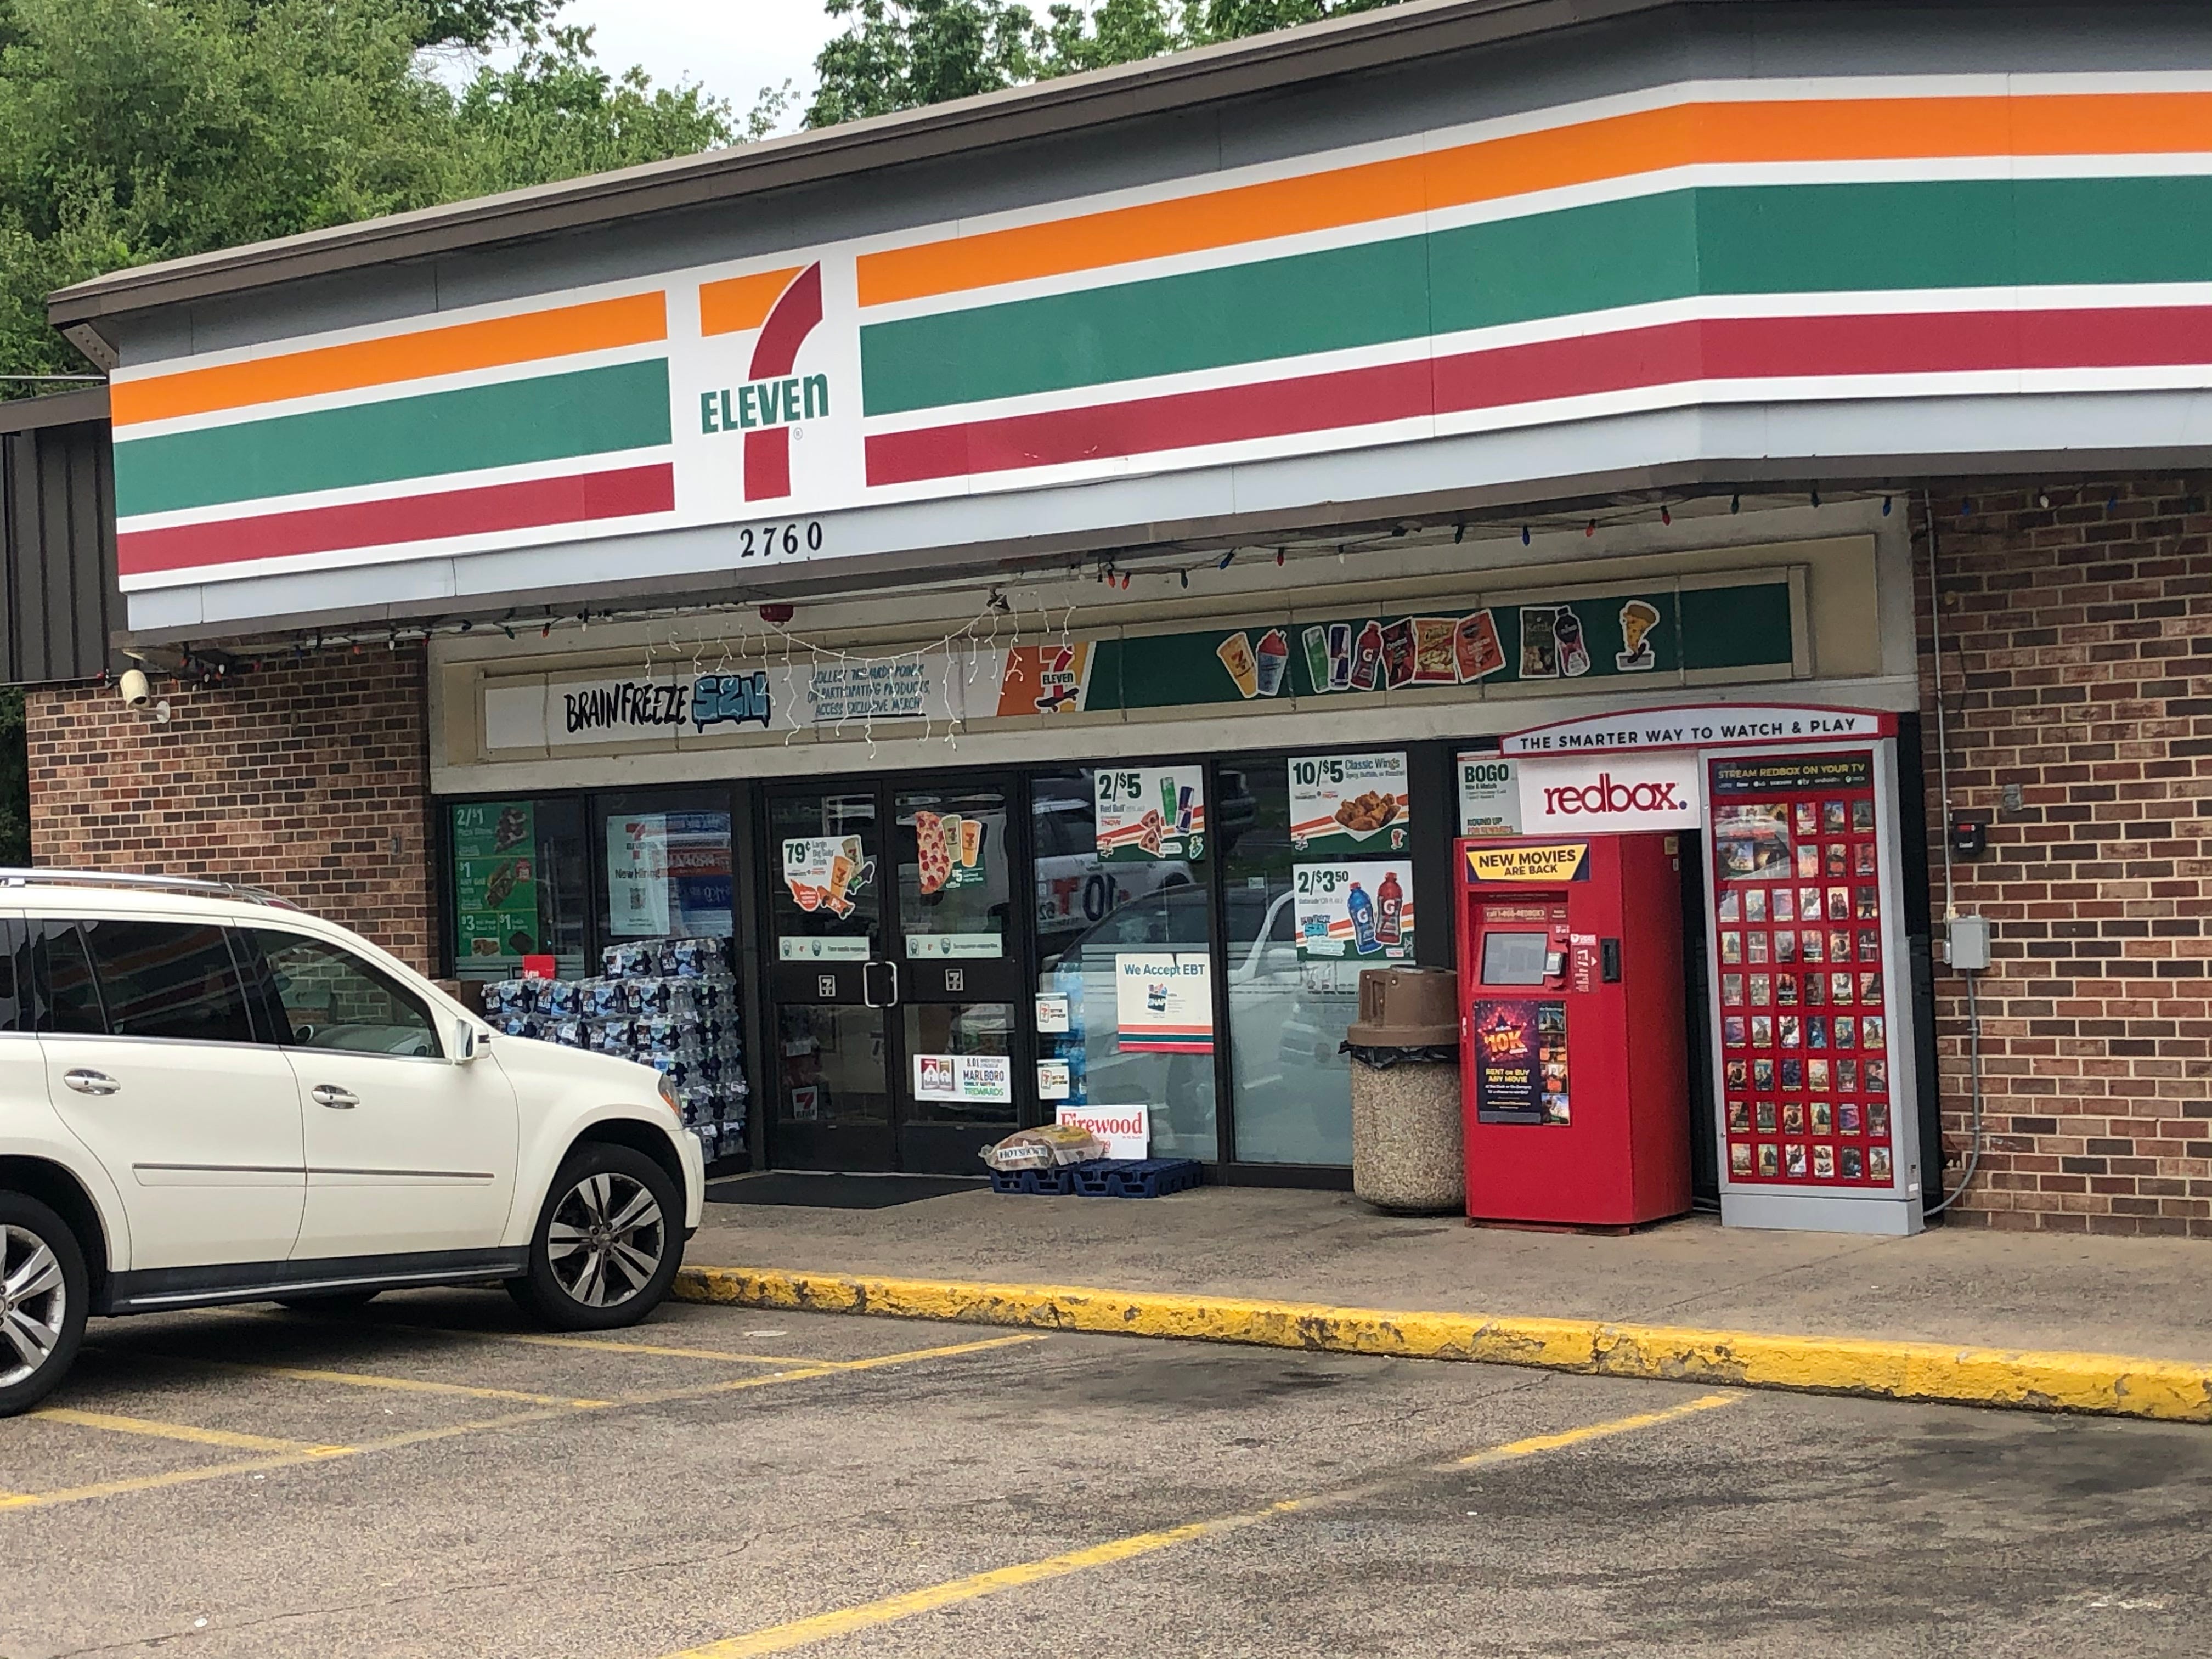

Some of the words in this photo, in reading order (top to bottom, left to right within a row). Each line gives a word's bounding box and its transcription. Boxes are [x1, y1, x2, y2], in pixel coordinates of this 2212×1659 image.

[699, 260, 824, 503] 7
[740, 521, 823, 558] 2760
[1520, 736, 1551, 750] THE
[1559, 731, 1638, 748] SMARTER
[1645, 729, 1684, 742] WAY
[1691, 727, 1713, 740] TO
[1721, 722, 1782, 738] WATCH
[1791, 721, 1802, 734] &
[1810, 718, 1855, 733] PLAY
[1345, 759, 1374, 770] Classic
[1374, 758, 1401, 770] Wings
[1718, 769, 1757, 779] STREAM
[1760, 766, 1801, 777] REDBOX
[1803, 765, 1818, 775] ON
[1821, 764, 1849, 774] YOUR
[1851, 763, 1865, 772] TV
[1293, 760, 1344, 787] 10/$5
[1464, 764, 1509, 783] BOGO
[1099, 772, 1142, 802] 2/$5
[785, 840, 811, 864] 79¢
[1479, 853, 1514, 868] NEW
[1519, 849, 1576, 865] MOVIES
[460, 861, 471, 878] $1
[1504, 866, 1526, 876] ARE
[1528, 864, 1558, 874] BACK
[1357, 907, 1368, 924] G
[1383, 899, 1395, 915] G
[461, 915, 475, 931] $3
[500, 914, 511, 930] $1
[1124, 963, 1141, 975] We
[1143, 963, 1181, 978] Accept
[1183, 963, 1205, 975] EBT
[963, 1070, 1005, 1082] MARLBORO
[1061, 1111, 1143, 1135] Firewood
